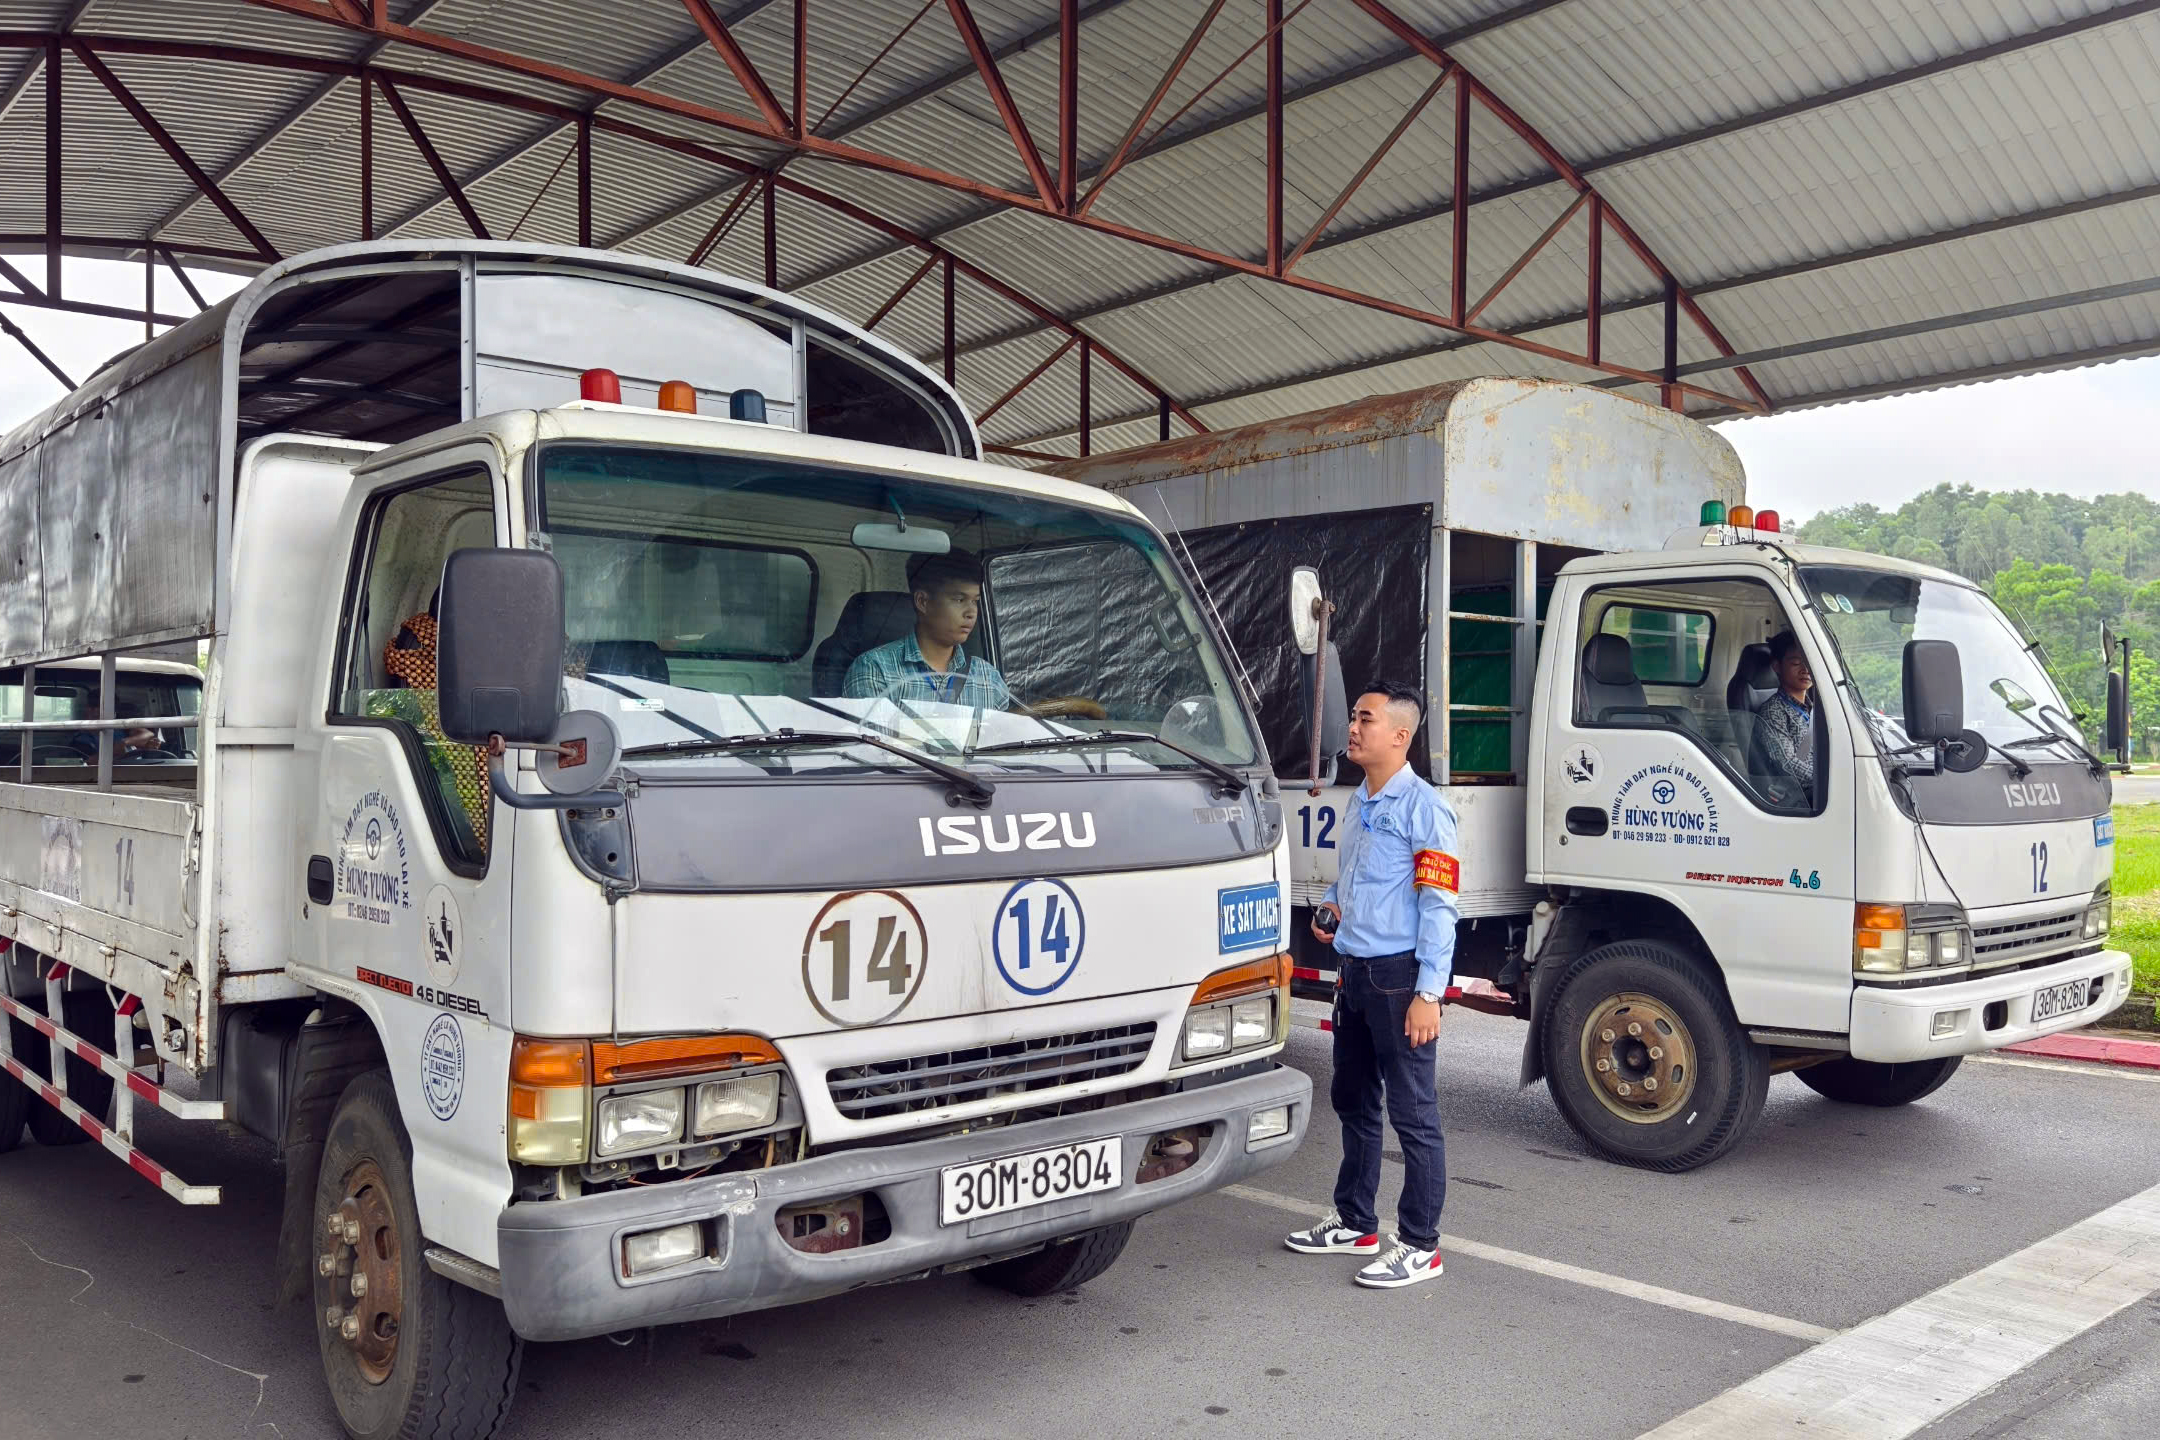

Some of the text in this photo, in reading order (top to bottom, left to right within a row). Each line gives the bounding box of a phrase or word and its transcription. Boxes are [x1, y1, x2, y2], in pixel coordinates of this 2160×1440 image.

[1612, 797, 1623, 826] TRUNG
[1700, 786, 1714, 804] TẠO
[1709, 822, 1718, 833] XE
[2003, 782, 2061, 808] ISUZU
[918, 811, 1097, 856] ISUZU
[1298, 805, 1336, 849] 12
[1624, 831, 1634, 841] 046
[1655, 833, 1666, 843] 233
[1686, 834, 1703, 845] 0912
[1704, 836, 1715, 846] 621
[1718, 836, 1730, 847] 828
[1625, 805, 1705, 831] HÙNG VƯƠNG
[116, 838, 134, 905] 14
[338, 847, 346, 893] TRUNG
[346, 859, 399, 905] HÙNG VƯƠNG
[1686, 871, 1784, 887] DIRECT INJECTION
[1790, 869, 1820, 889] 4.6
[2031, 841, 2048, 893] 12
[1009, 894, 1070, 970] 14
[1223, 895, 1278, 936] XE SÁT HẠCH
[819, 915, 912, 1002] 14
[416, 985, 488, 1016] 4.6 DIESEL
[2038, 983, 2085, 1017] 30M-8260
[955, 1145, 1112, 1215] 30M-8304
